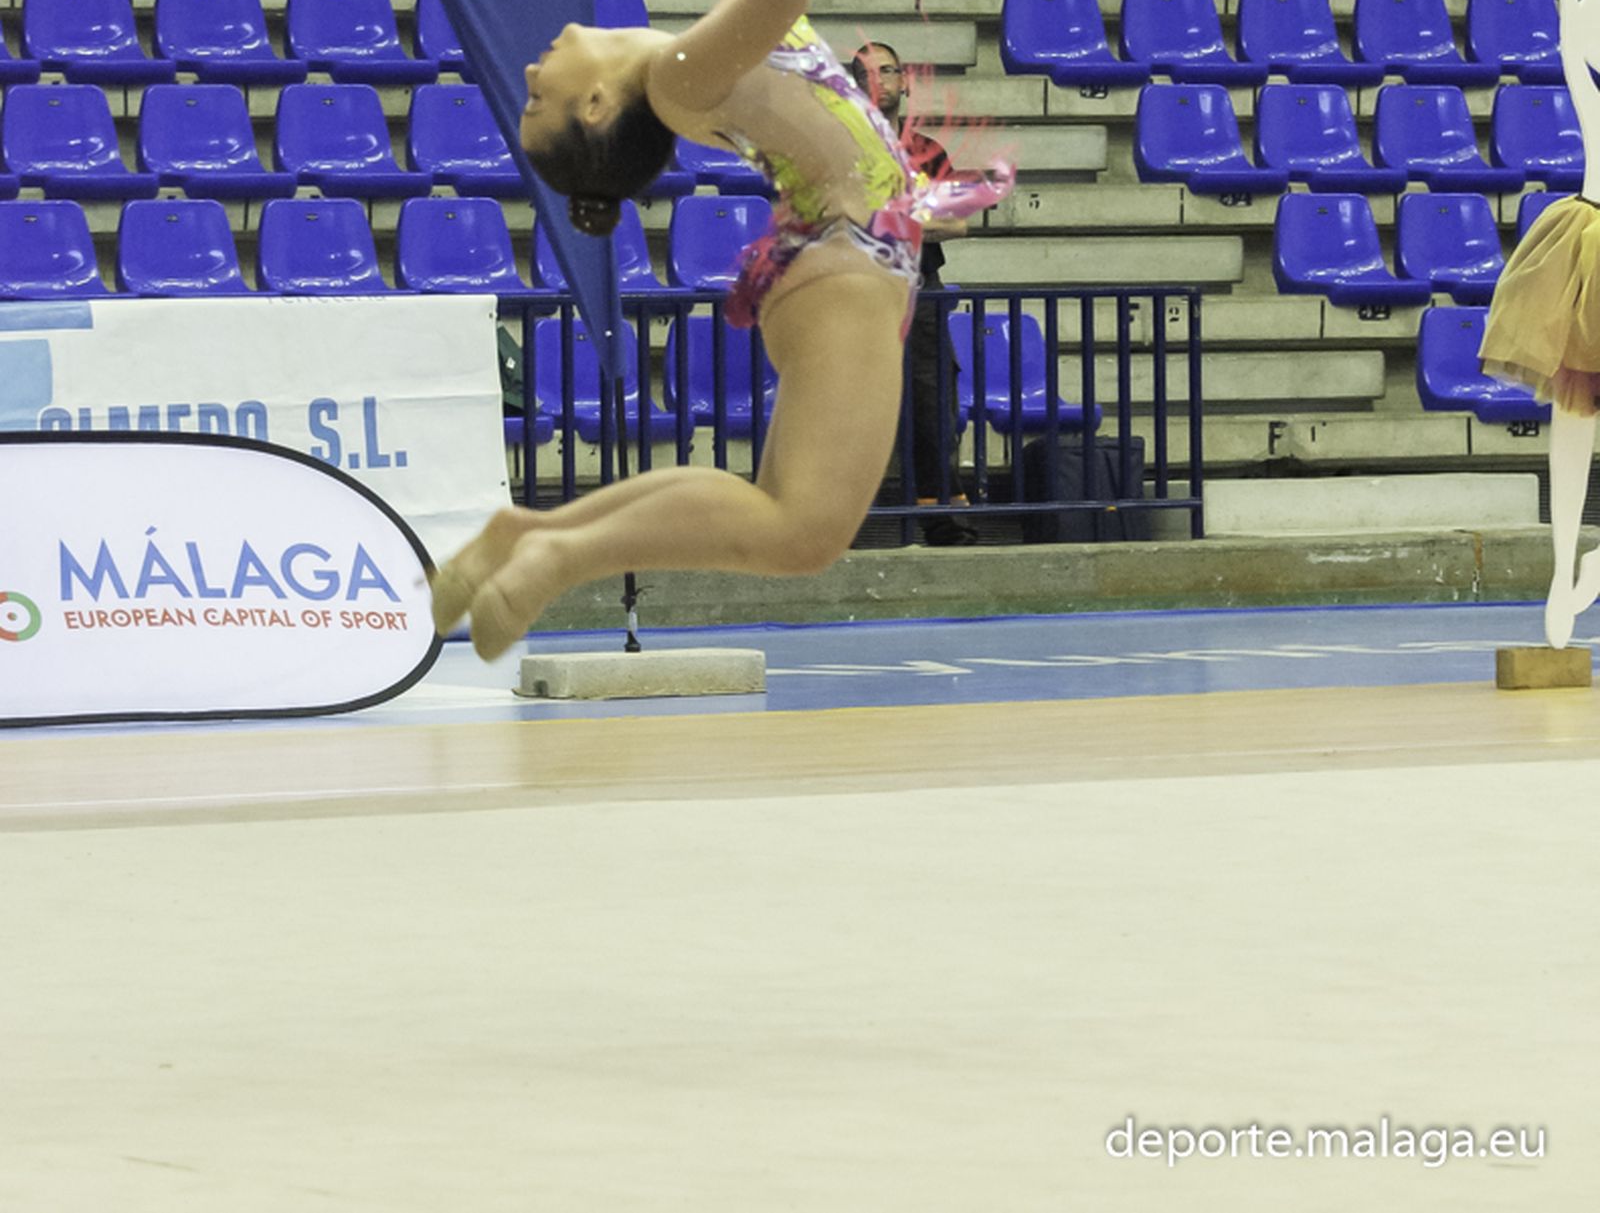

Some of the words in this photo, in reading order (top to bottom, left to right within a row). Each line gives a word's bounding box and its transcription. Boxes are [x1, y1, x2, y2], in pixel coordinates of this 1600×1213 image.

[308, 395, 408, 469] S.L.
[1268, 420, 1288, 456] F
[59, 525, 402, 603] MÁLAGA
[64, 608, 197, 630] EUROPEAN
[203, 608, 297, 628] CAPITAL
[301, 609, 333, 629] OF
[340, 611, 408, 631] SPORT
